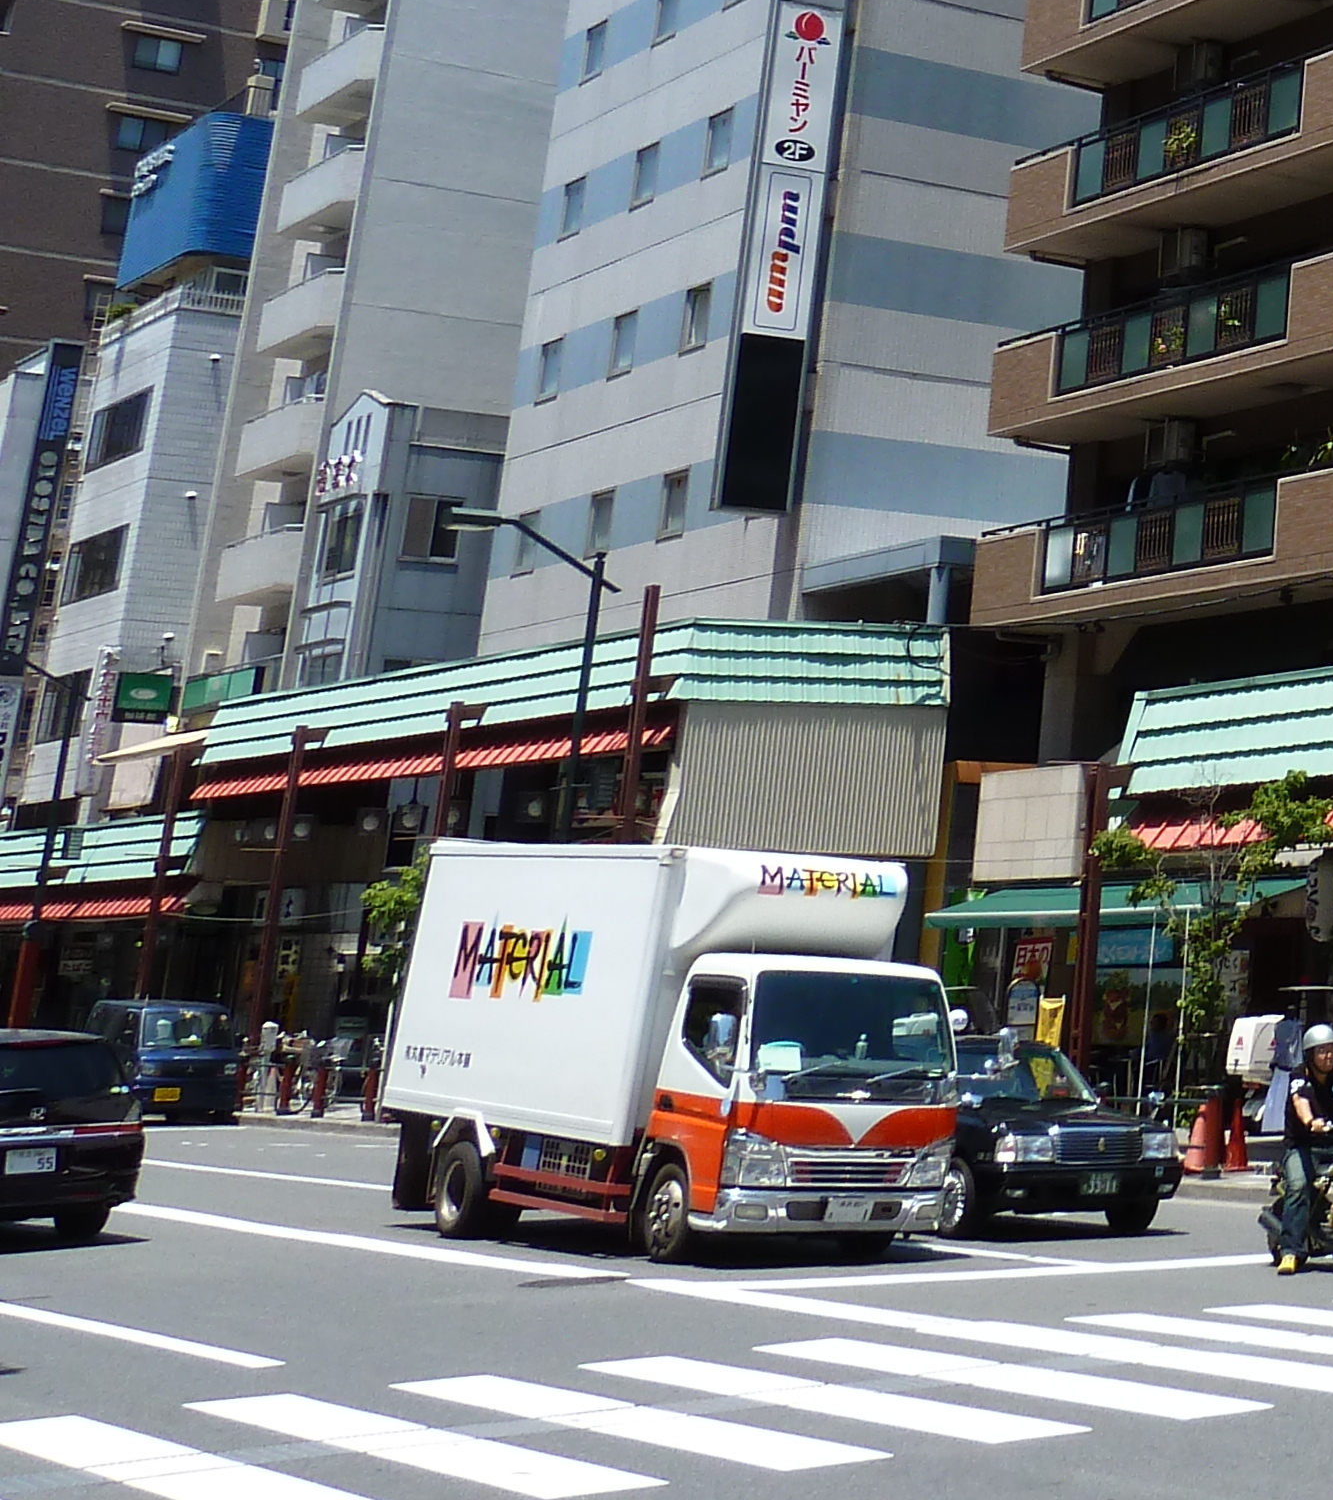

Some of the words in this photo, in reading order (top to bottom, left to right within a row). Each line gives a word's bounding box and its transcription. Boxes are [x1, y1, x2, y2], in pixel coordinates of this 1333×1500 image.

[787, 45, 817, 134] バーミヤン
[781, 141, 809, 160] 2F
[760, 863, 895, 898] MATERIAL
[453, 912, 583, 1000] MATERIAL
